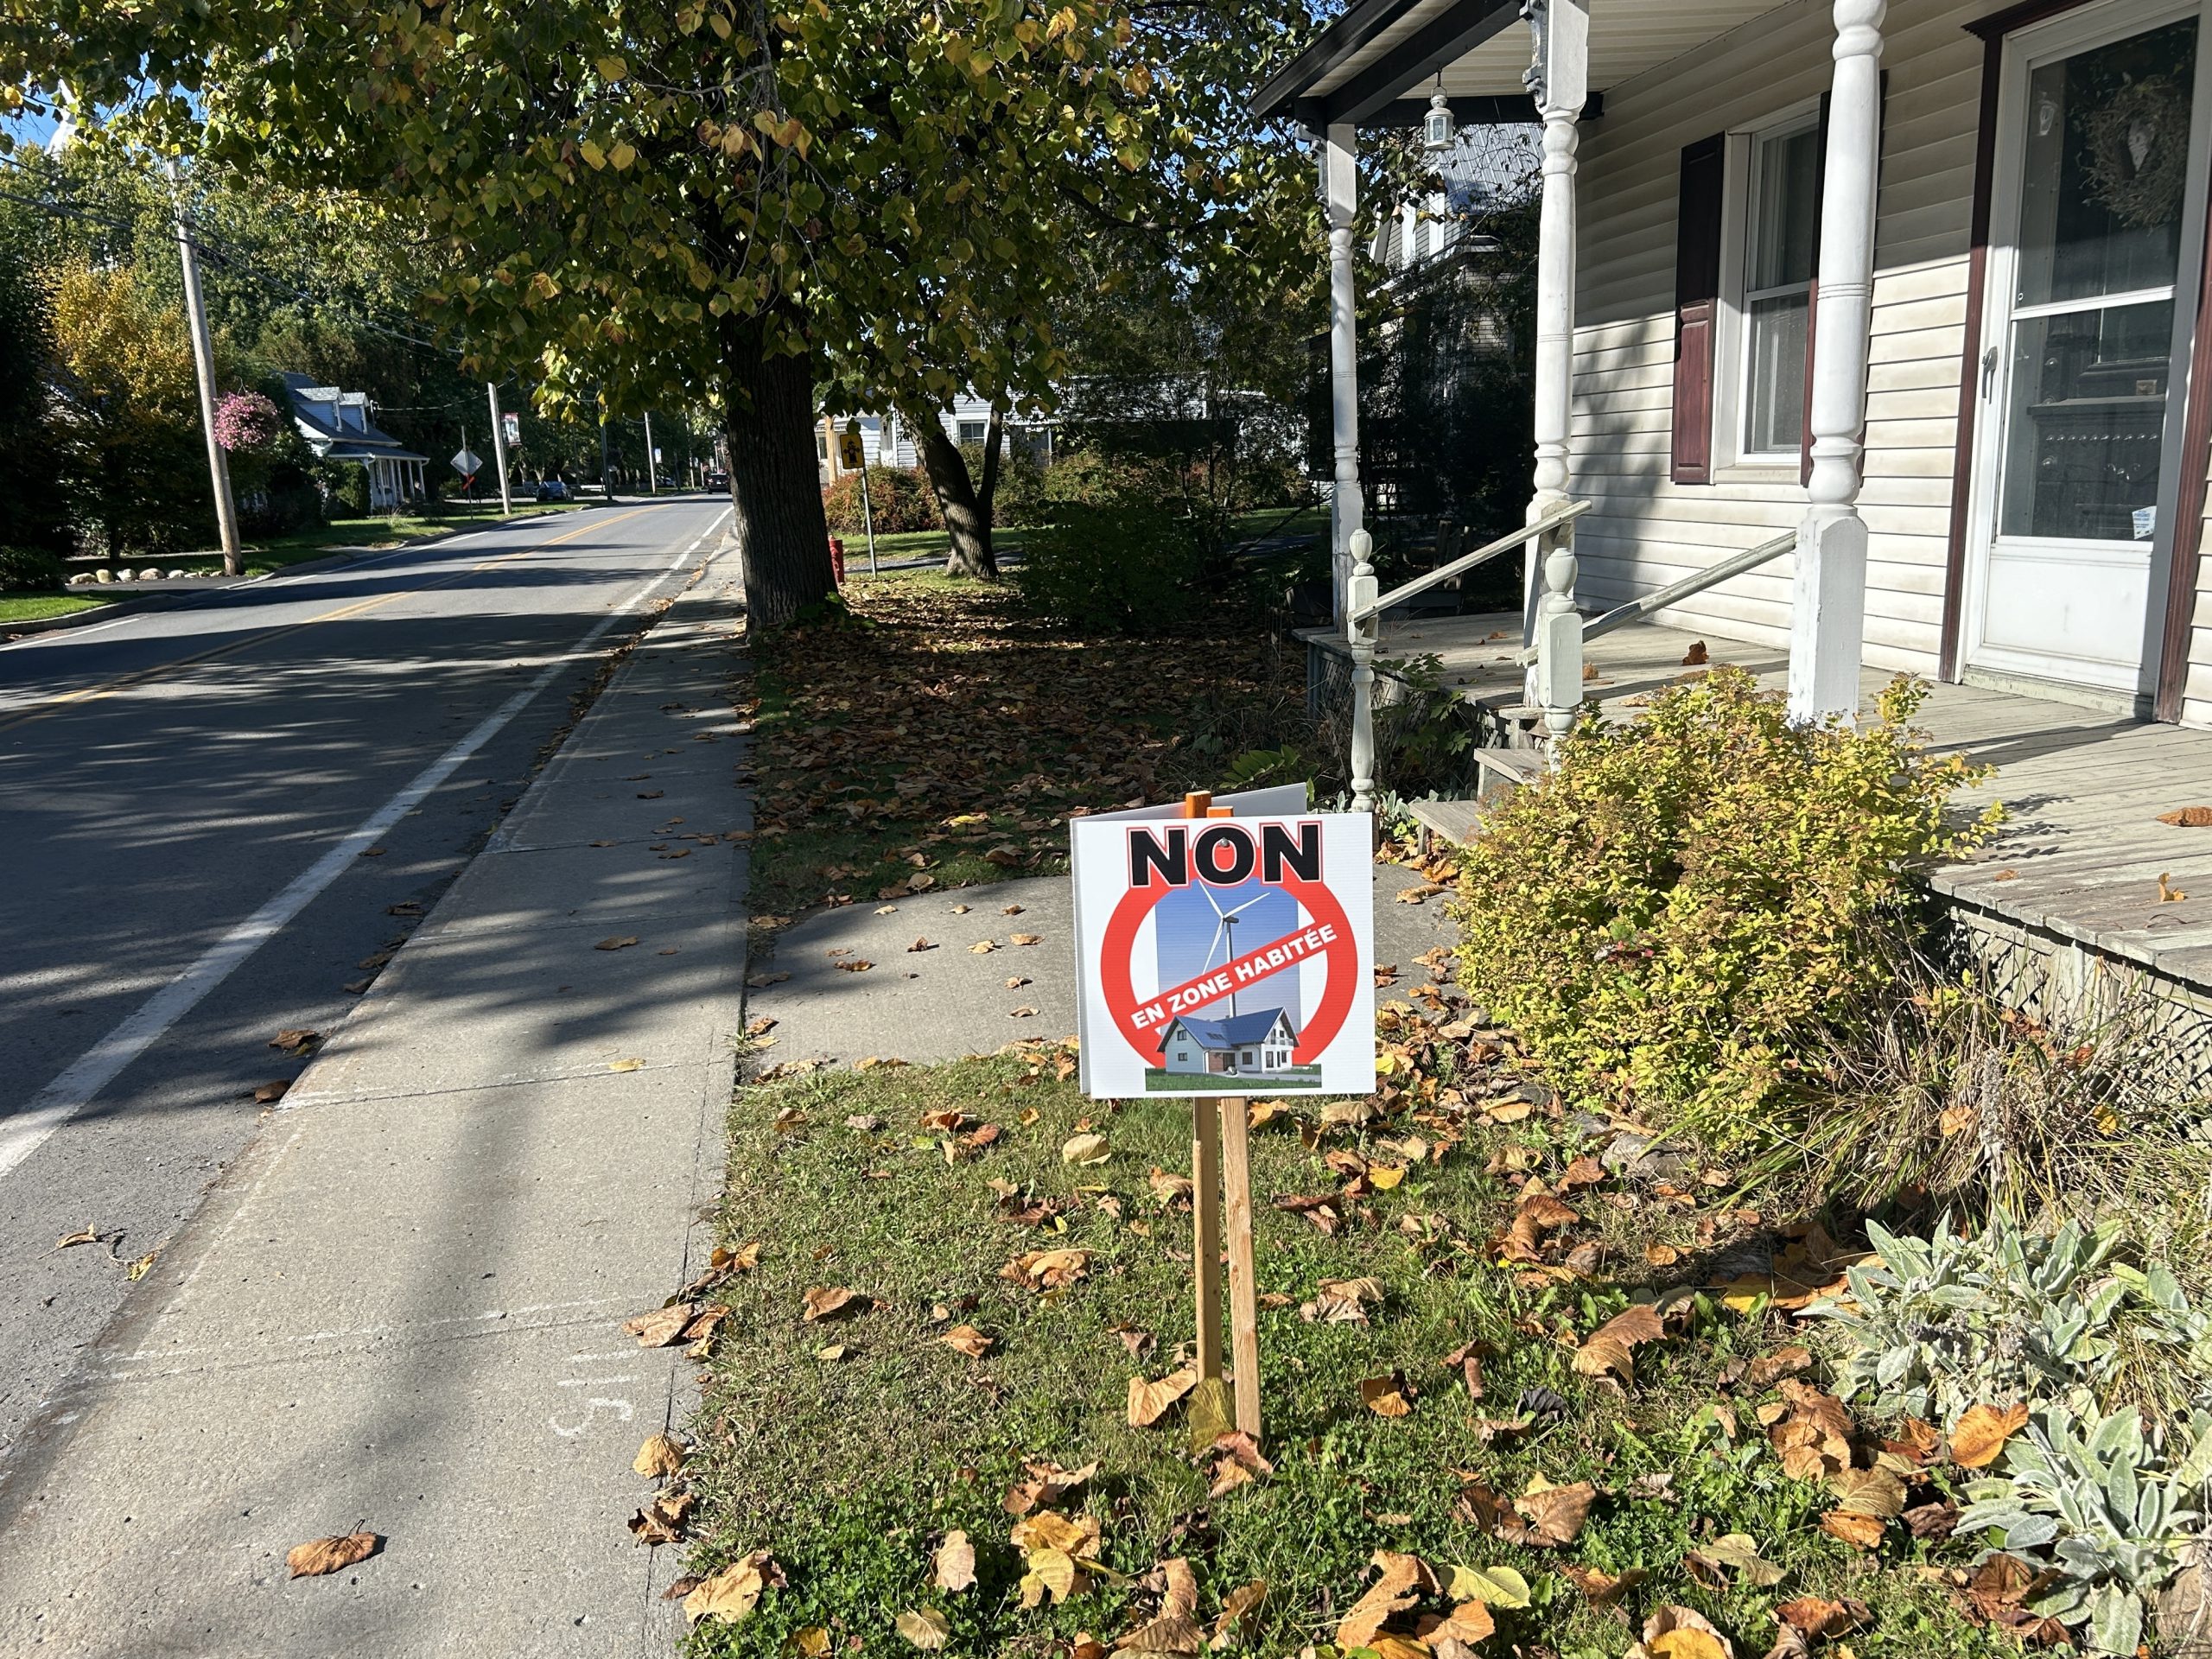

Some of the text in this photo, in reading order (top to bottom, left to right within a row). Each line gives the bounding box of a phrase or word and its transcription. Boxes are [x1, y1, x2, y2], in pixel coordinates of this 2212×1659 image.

[1127, 822, 1323, 888] NON
[1131, 924, 1338, 1029] EN ZONE HABITÉE
